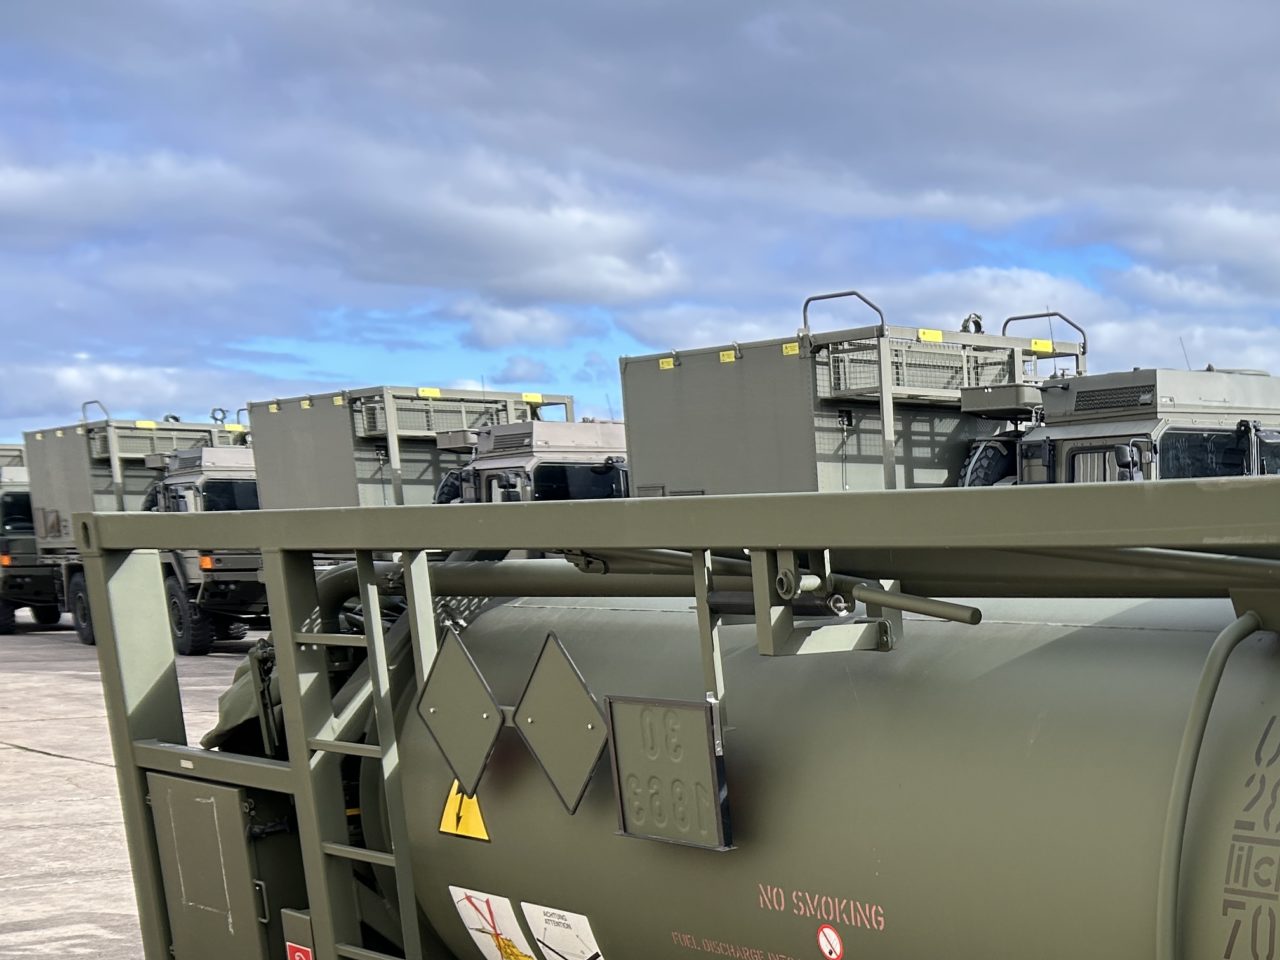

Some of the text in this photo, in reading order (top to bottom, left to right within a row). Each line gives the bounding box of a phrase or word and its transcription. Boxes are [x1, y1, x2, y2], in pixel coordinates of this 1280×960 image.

[759, 883, 884, 931] NO SMOKING
[671, 931, 700, 950] FUEL
